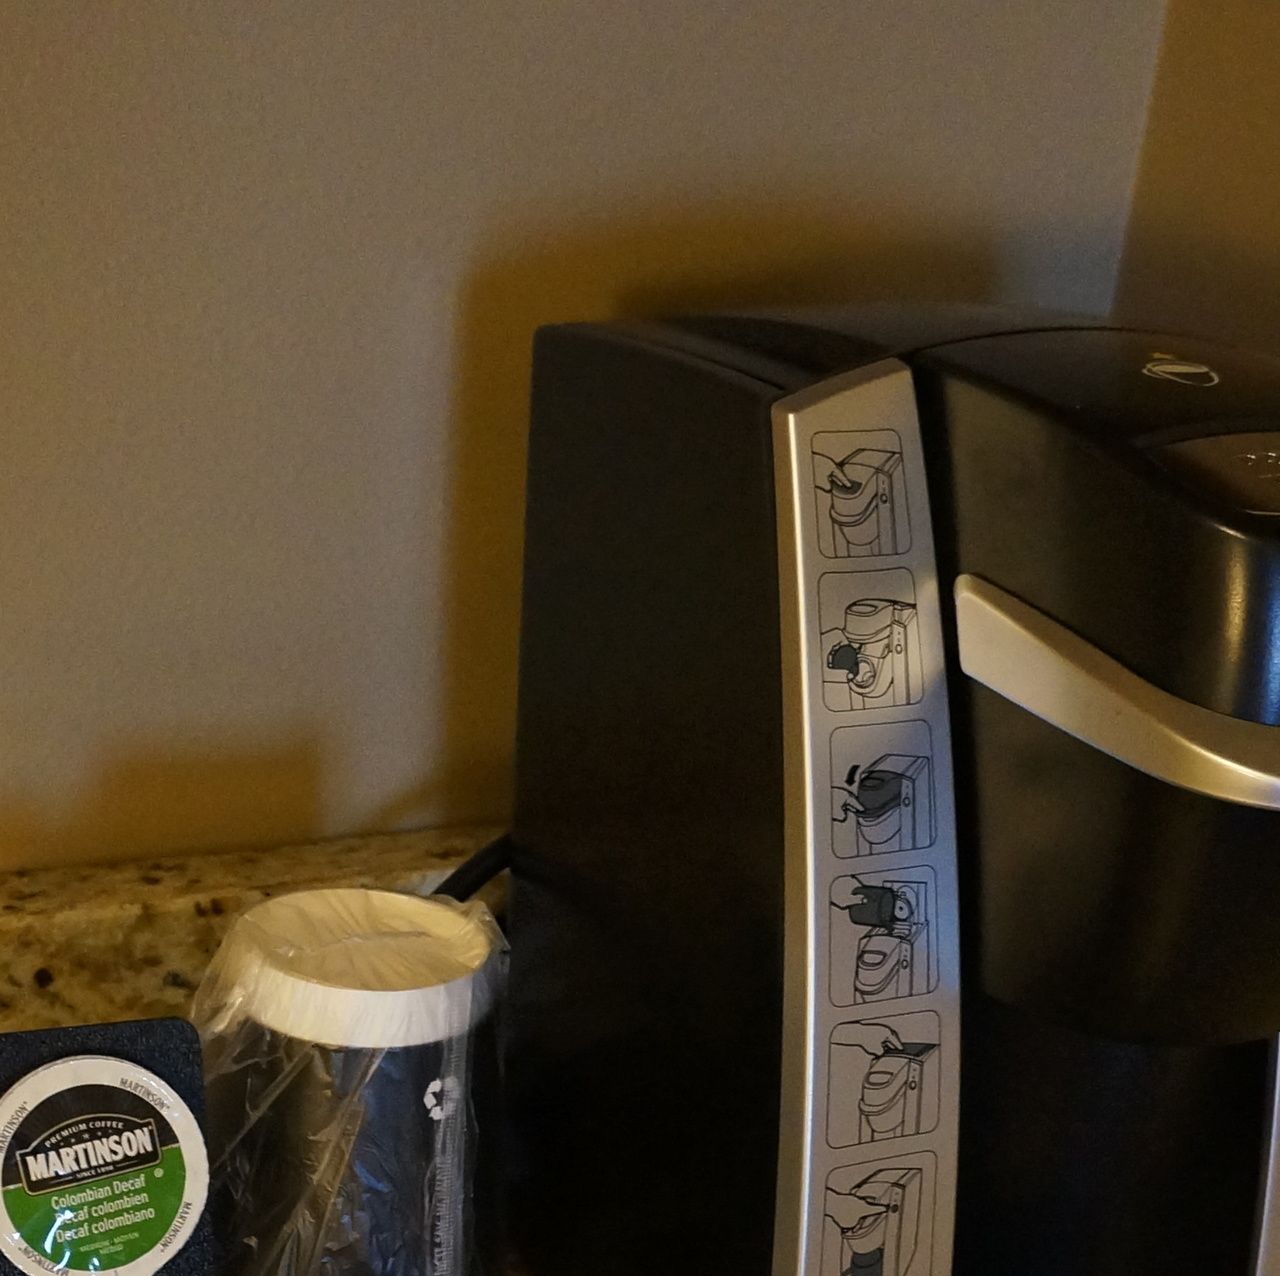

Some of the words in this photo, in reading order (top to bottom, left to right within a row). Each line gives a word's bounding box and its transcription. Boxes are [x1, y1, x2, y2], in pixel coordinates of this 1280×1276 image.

[44, 1122, 88, 1148] PREMIUM
[89, 1120, 125, 1130] COFFEE
[25, 1129, 153, 1182] MARTINSON
[51, 1184, 111, 1210] Colombian
[113, 1174, 146, 1195] Decaf
[92, 1193, 149, 1218] colombien
[91, 1208, 156, 1235] colombiano
